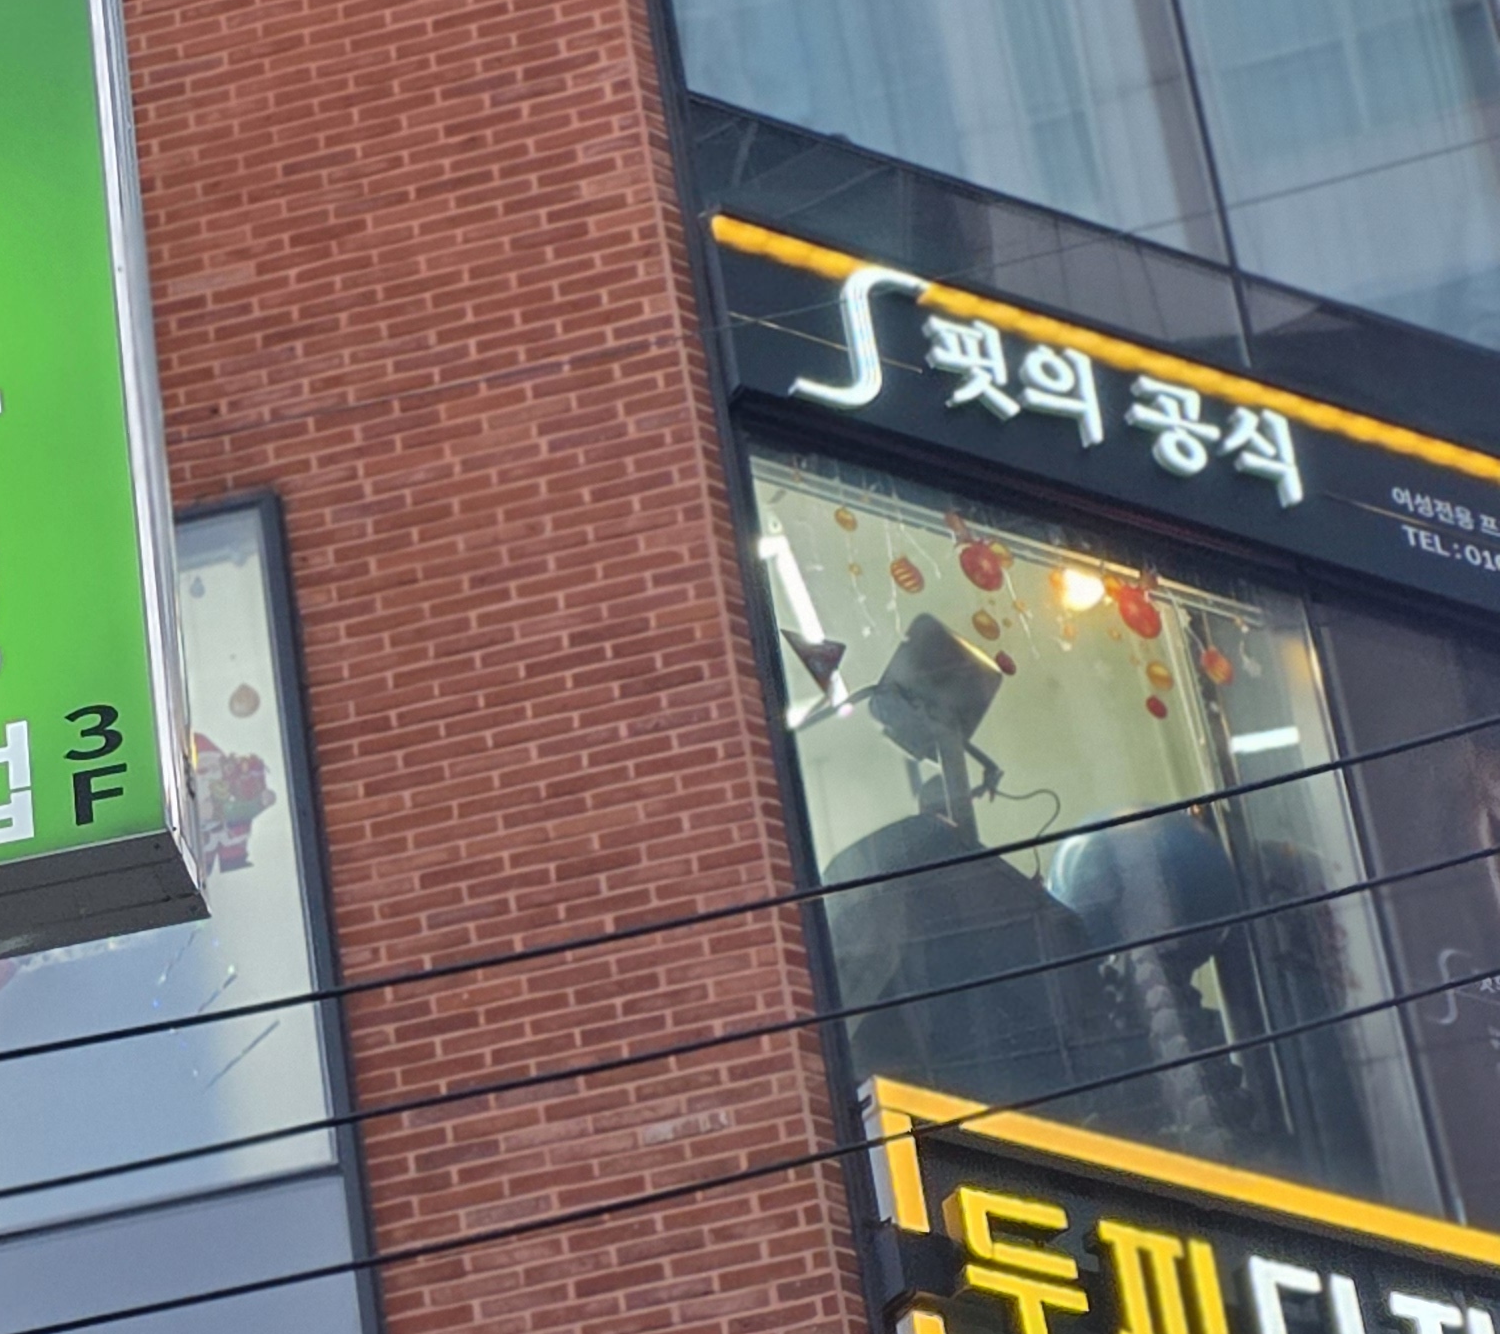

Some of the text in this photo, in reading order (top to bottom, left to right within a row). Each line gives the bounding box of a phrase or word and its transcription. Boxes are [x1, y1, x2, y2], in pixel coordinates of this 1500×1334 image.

[922, 316, 1304, 508] 핏의 공식
[1391, 487, 1475, 531] 여성전용
[62, 704, 128, 826] 3F
